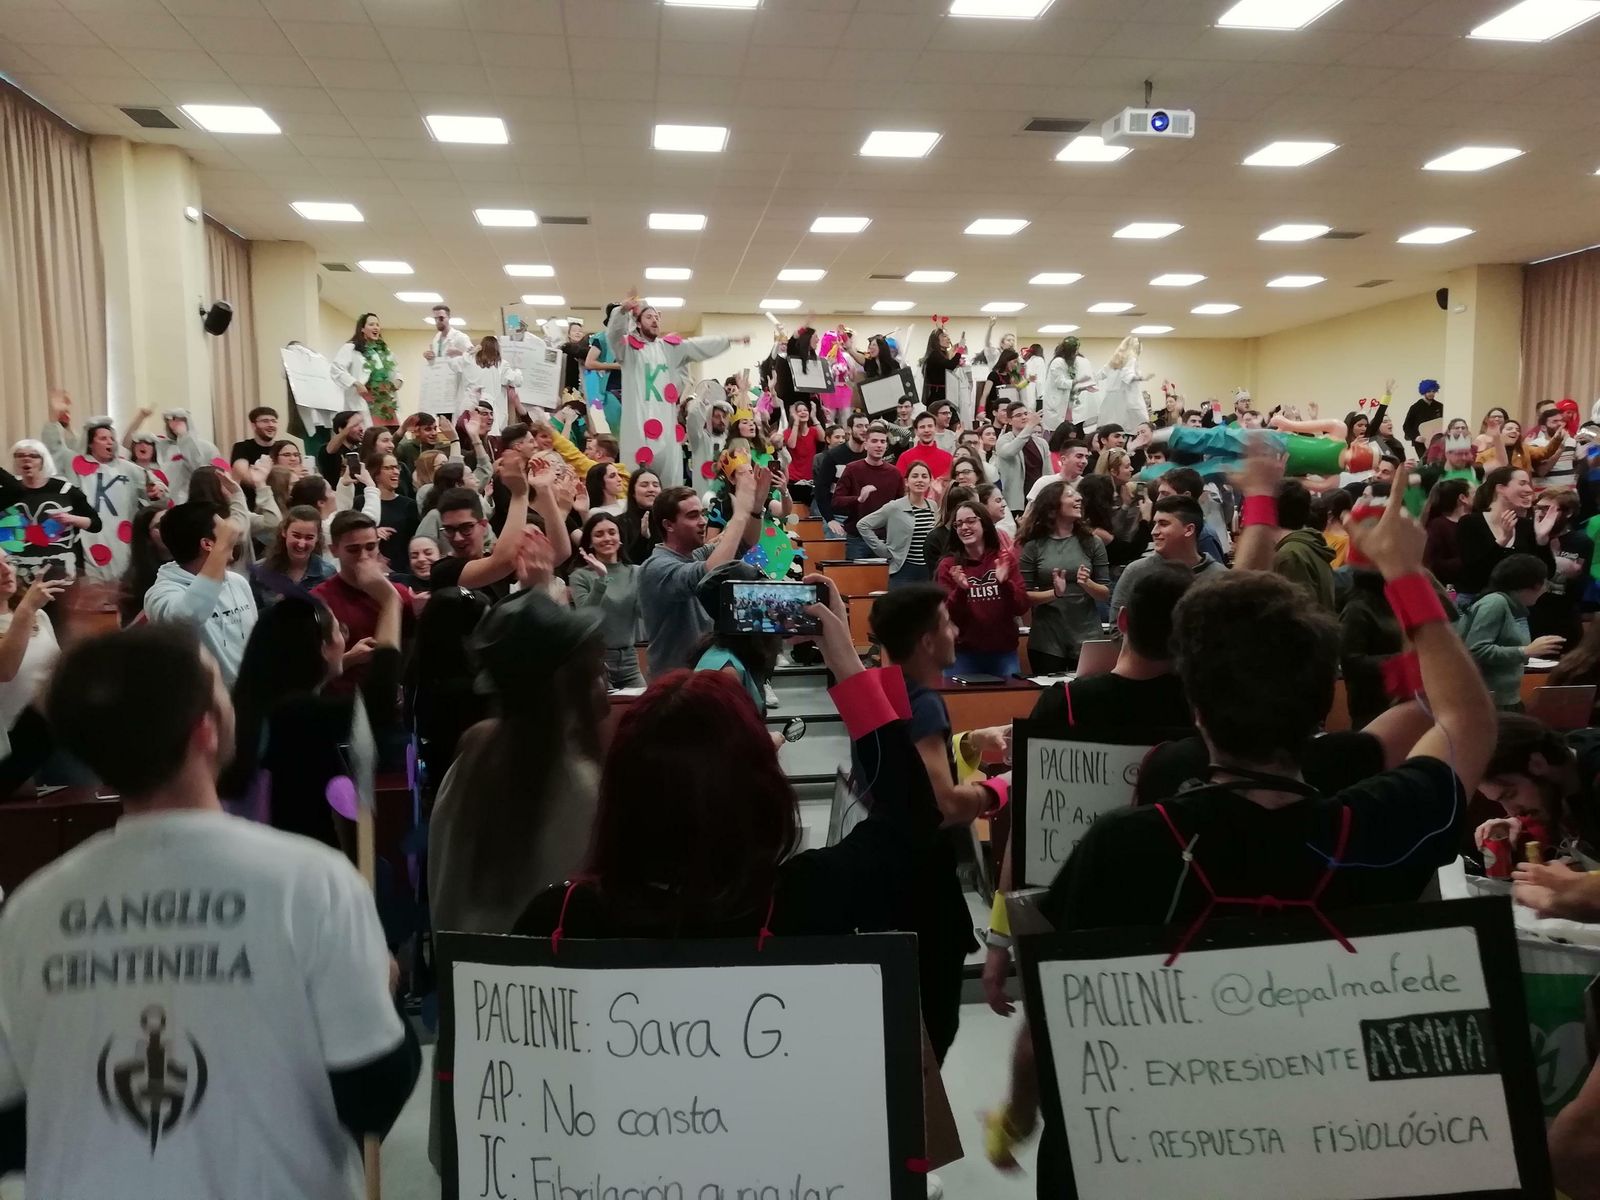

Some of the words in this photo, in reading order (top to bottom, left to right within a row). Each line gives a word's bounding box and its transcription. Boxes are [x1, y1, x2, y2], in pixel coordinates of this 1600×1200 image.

[969, 585, 999, 598] LLIST
[59, 889, 246, 936] GANGLIO
[42, 942, 254, 993] CENTINELA
[1063, 968, 1203, 1028] PACIENTE:
[1211, 951, 1462, 1017] @depalmafede
[473, 980, 592, 1054] PACIENTE:
[606, 992, 721, 1058] Sara
[743, 993, 789, 1058] G.
[1081, 1040, 1135, 1096] AP:
[1367, 1014, 1487, 1079] AEMMA
[477, 1060, 526, 1127] AP:
[542, 1079, 596, 1137] No
[618, 1095, 729, 1137] consta
[1149, 1127, 1285, 1159] RESPUESTA
